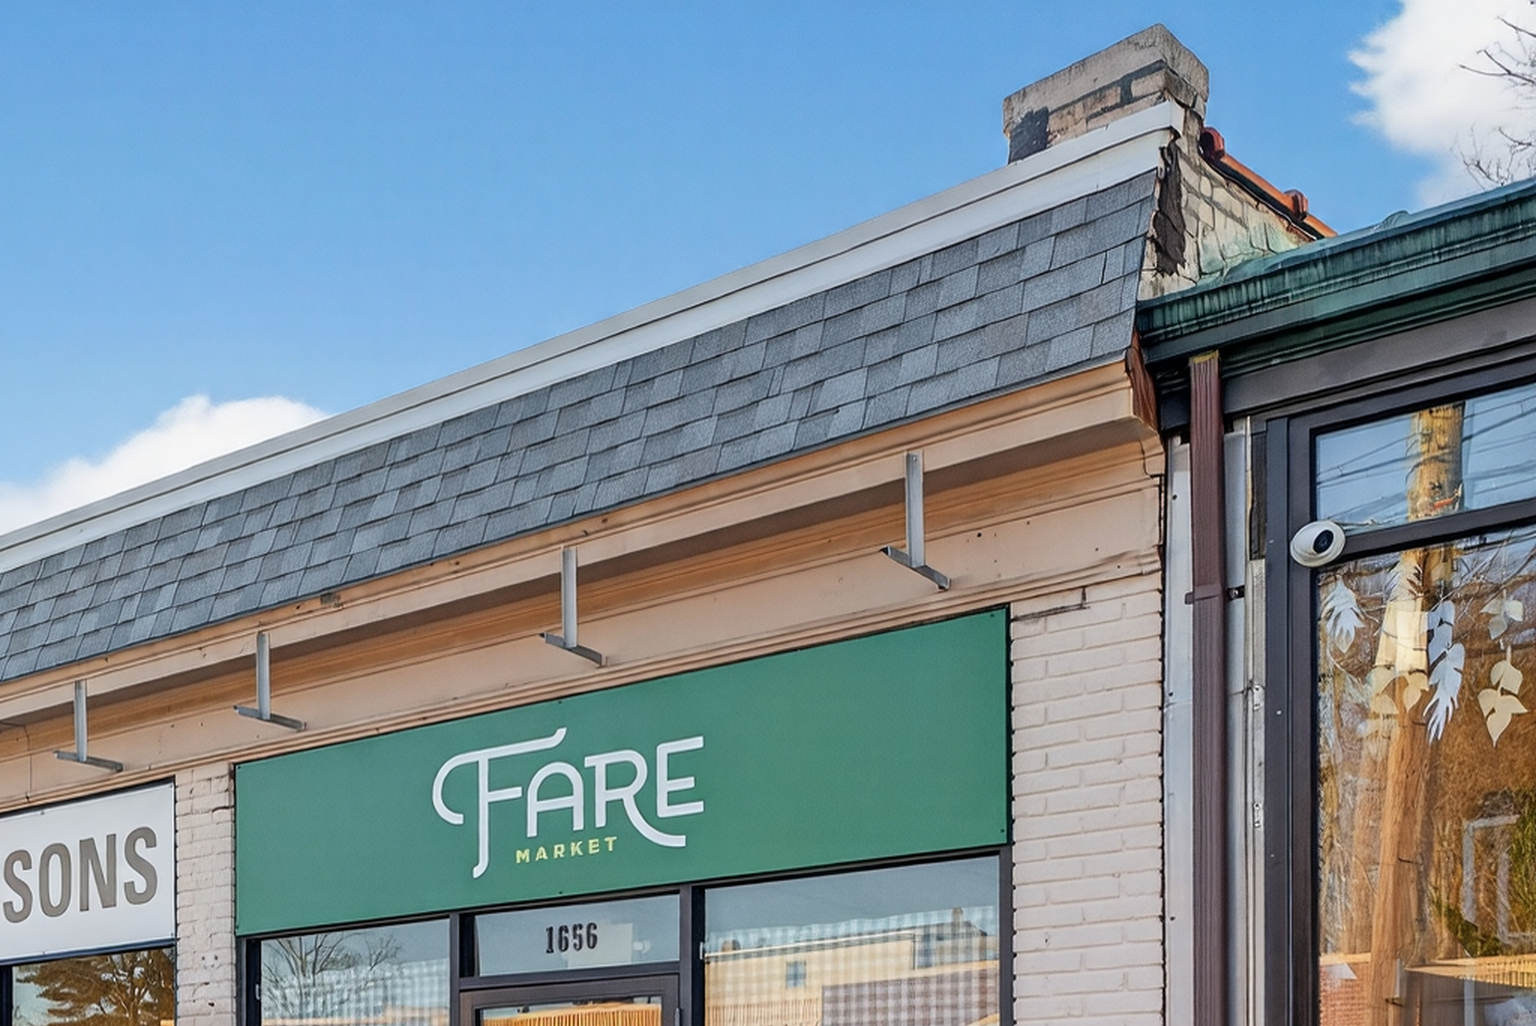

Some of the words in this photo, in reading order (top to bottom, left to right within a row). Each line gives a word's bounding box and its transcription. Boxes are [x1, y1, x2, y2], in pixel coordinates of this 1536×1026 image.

[432, 727, 704, 879] FARE
[515, 836, 618, 864] MARKET
[545, 922, 598, 954] 1656
